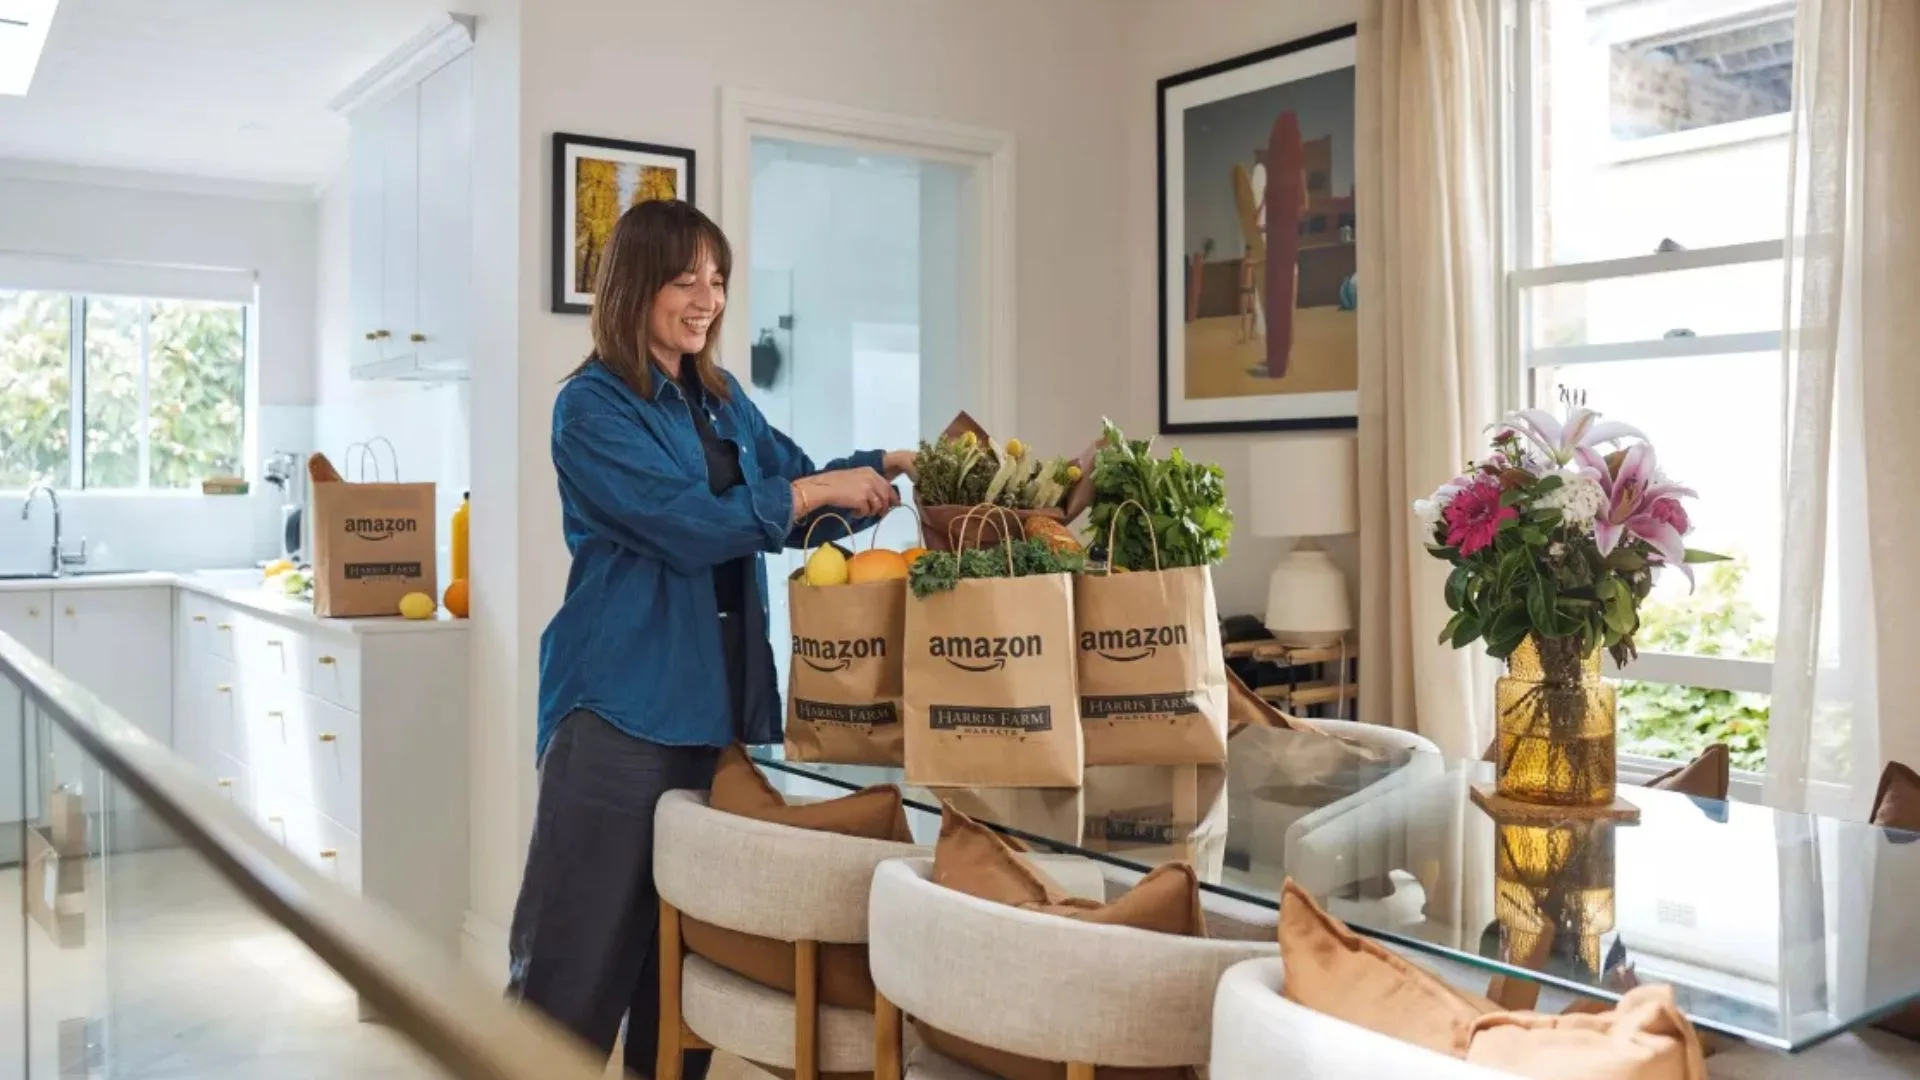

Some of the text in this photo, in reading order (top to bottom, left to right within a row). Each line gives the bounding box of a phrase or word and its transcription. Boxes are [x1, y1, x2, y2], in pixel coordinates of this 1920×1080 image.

[344, 518, 417, 533] amazon
[929, 634, 1043, 658] amazon
[1080, 624, 1188, 651] amazon
[792, 635, 886, 660] amazon
[800, 702, 845, 720] HARRIS
[1088, 699, 1147, 714] HARRIS
[938, 708, 1046, 726] HARRIS FARM
